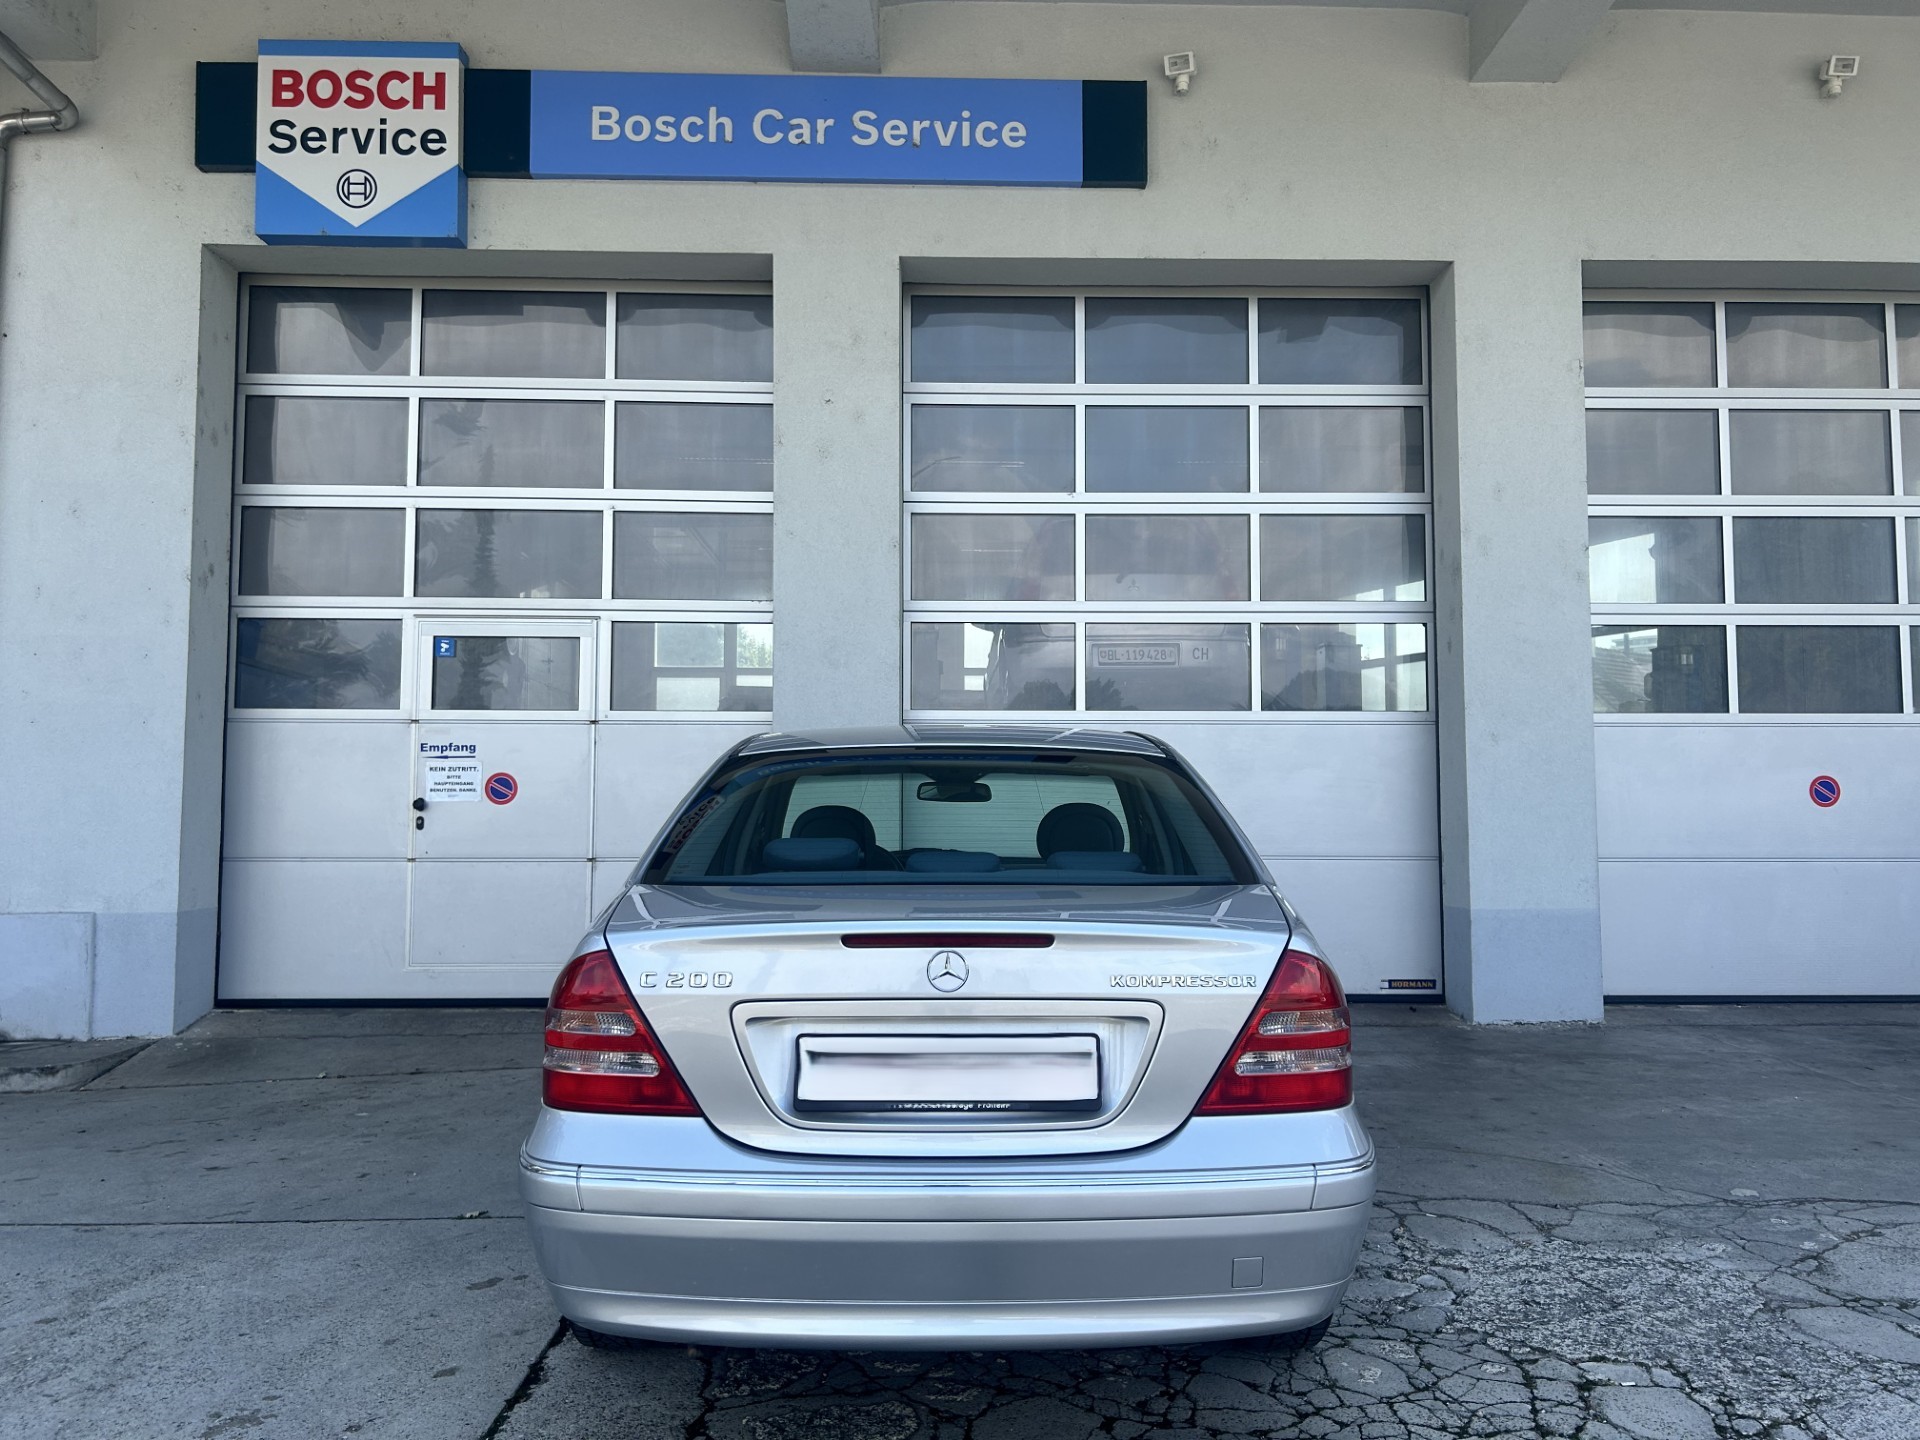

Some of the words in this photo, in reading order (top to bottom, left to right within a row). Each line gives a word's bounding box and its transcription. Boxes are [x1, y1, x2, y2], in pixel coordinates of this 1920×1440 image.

[271, 69, 447, 111] BOSCH
[591, 105, 733, 144] Bosch
[752, 108, 834, 146] Car
[851, 110, 1028, 149] Service
[267, 118, 448, 157] Service
[1192, 647, 1209, 660] CH
[420, 742, 476, 754] Empfang
[640, 971, 657, 988] C
[665, 971, 733, 988] 200
[1110, 974, 1256, 987] KOMPRESSOR
